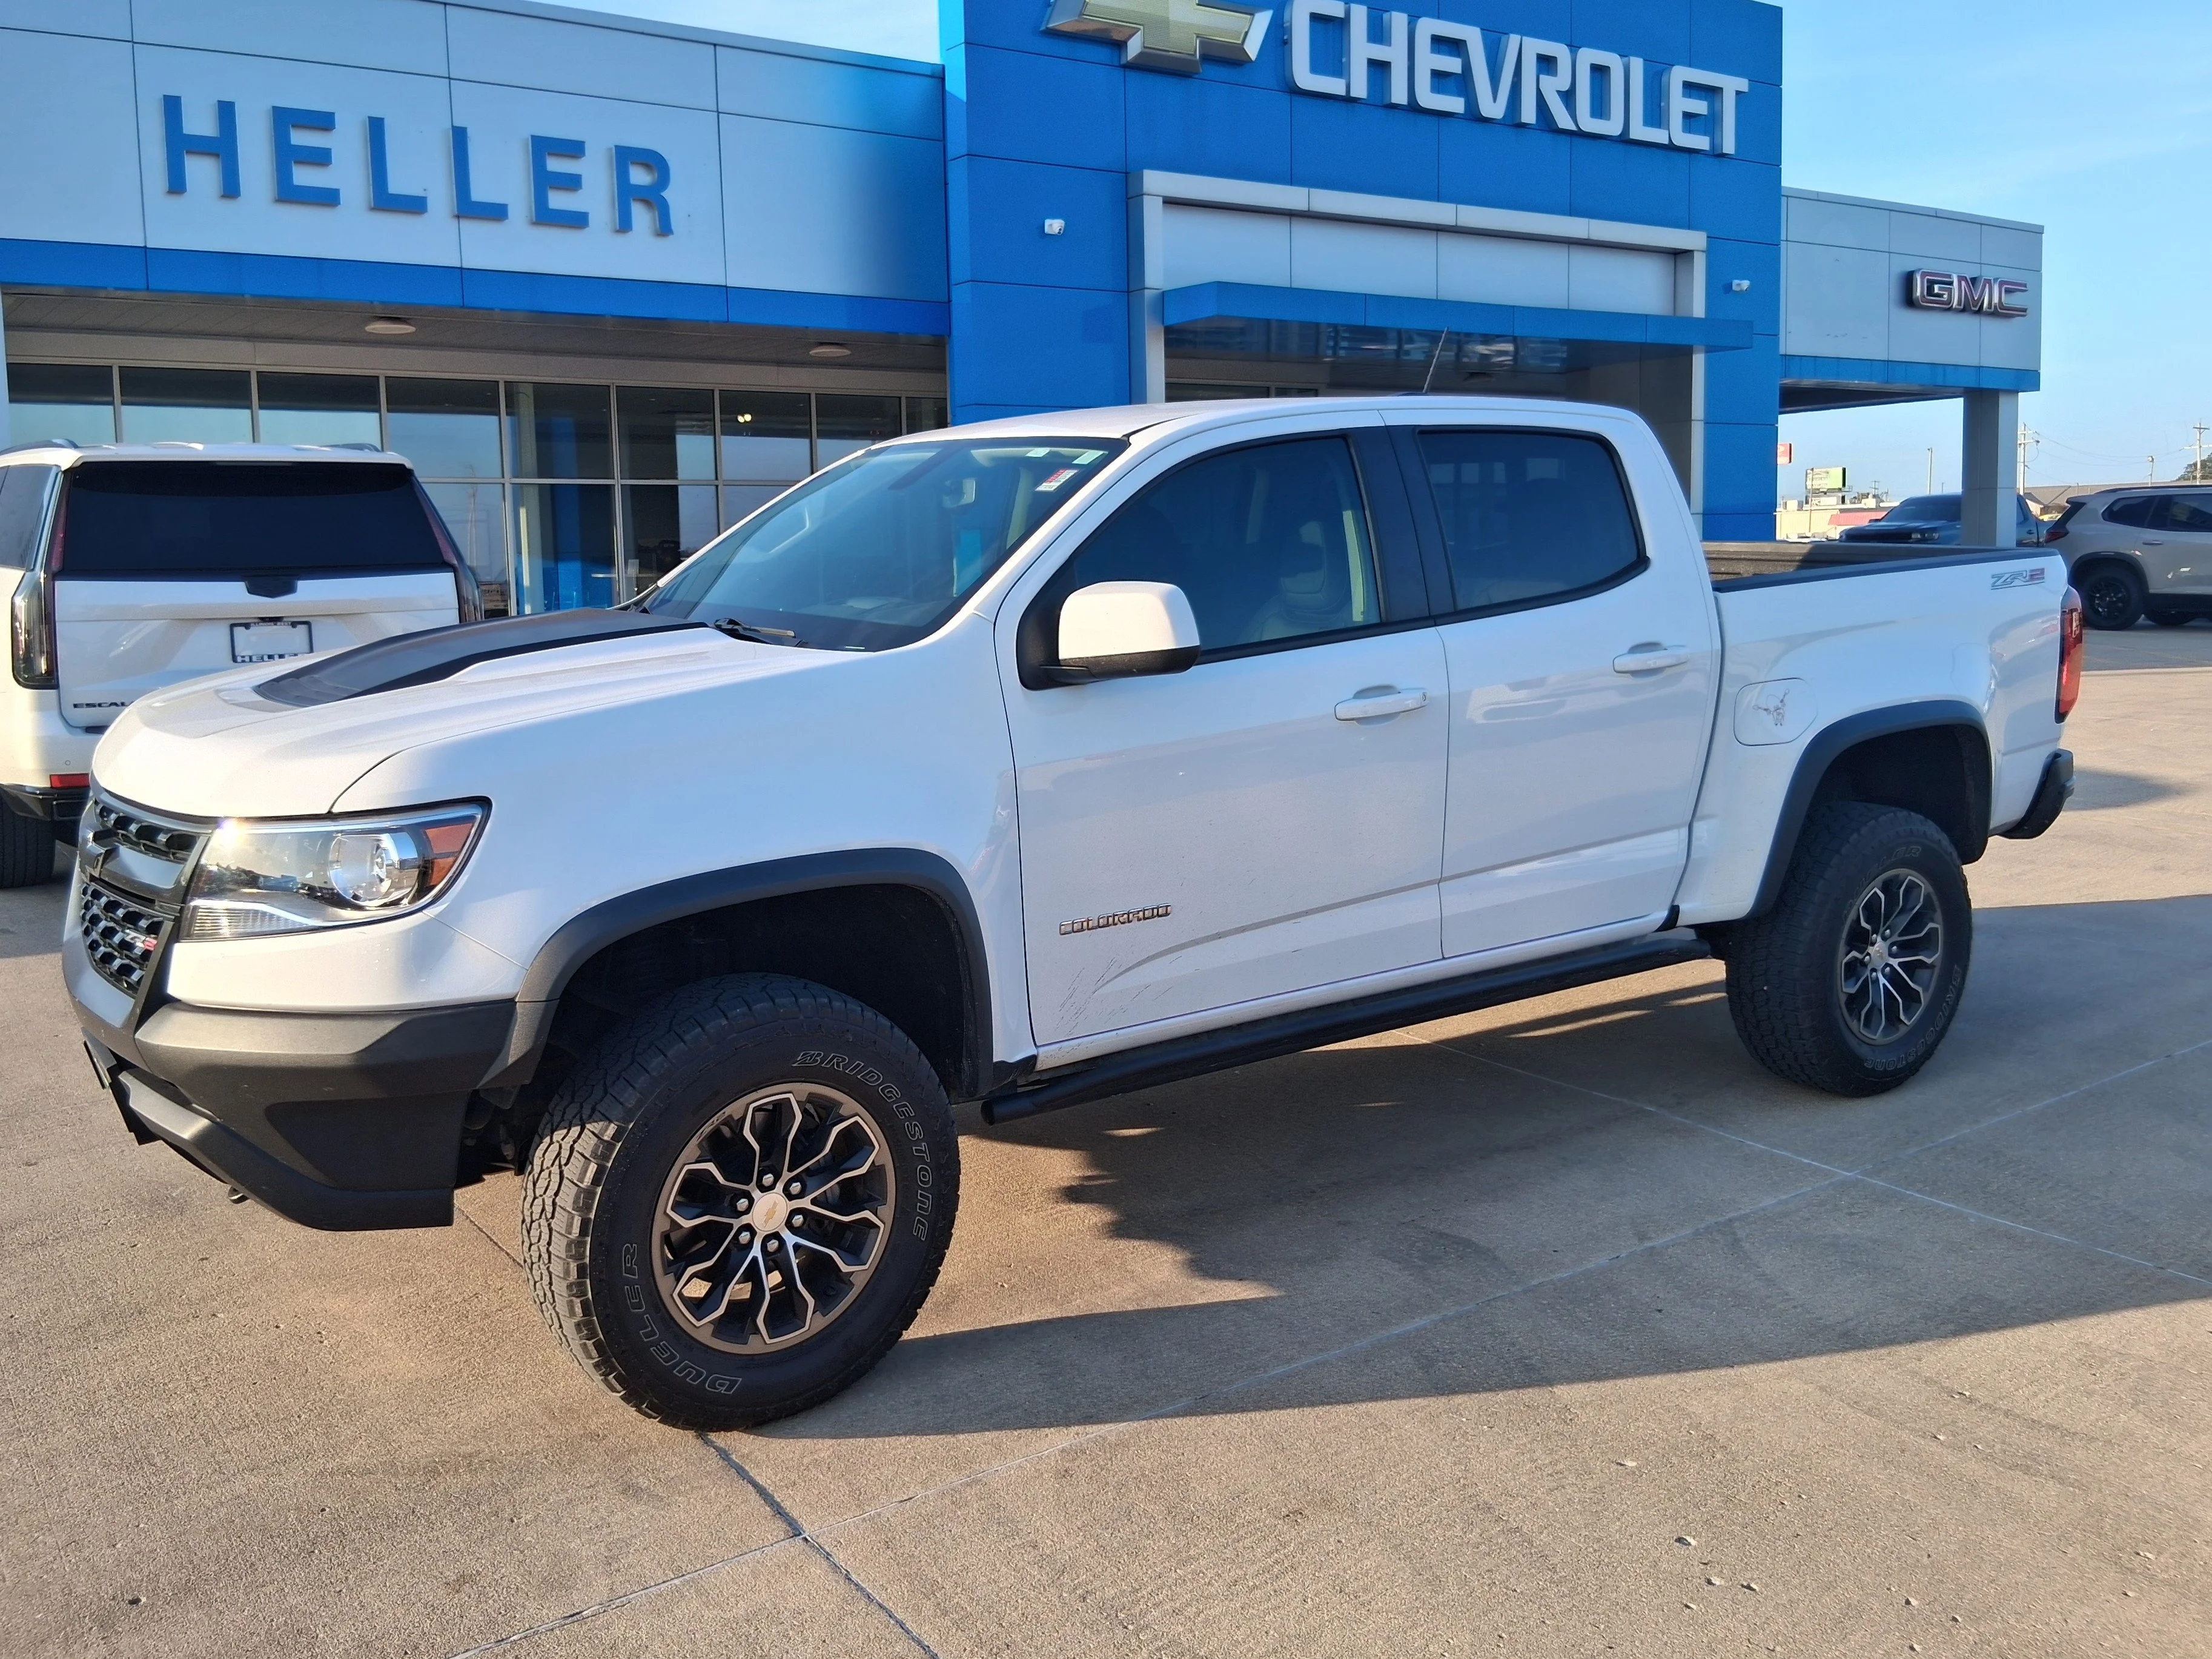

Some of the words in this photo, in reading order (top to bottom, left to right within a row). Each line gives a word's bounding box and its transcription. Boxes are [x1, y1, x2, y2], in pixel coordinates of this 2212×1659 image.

[1283, 0, 1749, 155] CHEVROLET
[162, 94, 674, 236] HELLER
[1912, 269, 2028, 317] GMC
[1991, 568, 2045, 590] ZR2
[1059, 902, 1172, 936] COLORADO
[791, 1050, 933, 1242] BRIDGESTONE
[622, 1242, 743, 1394] DUELER
